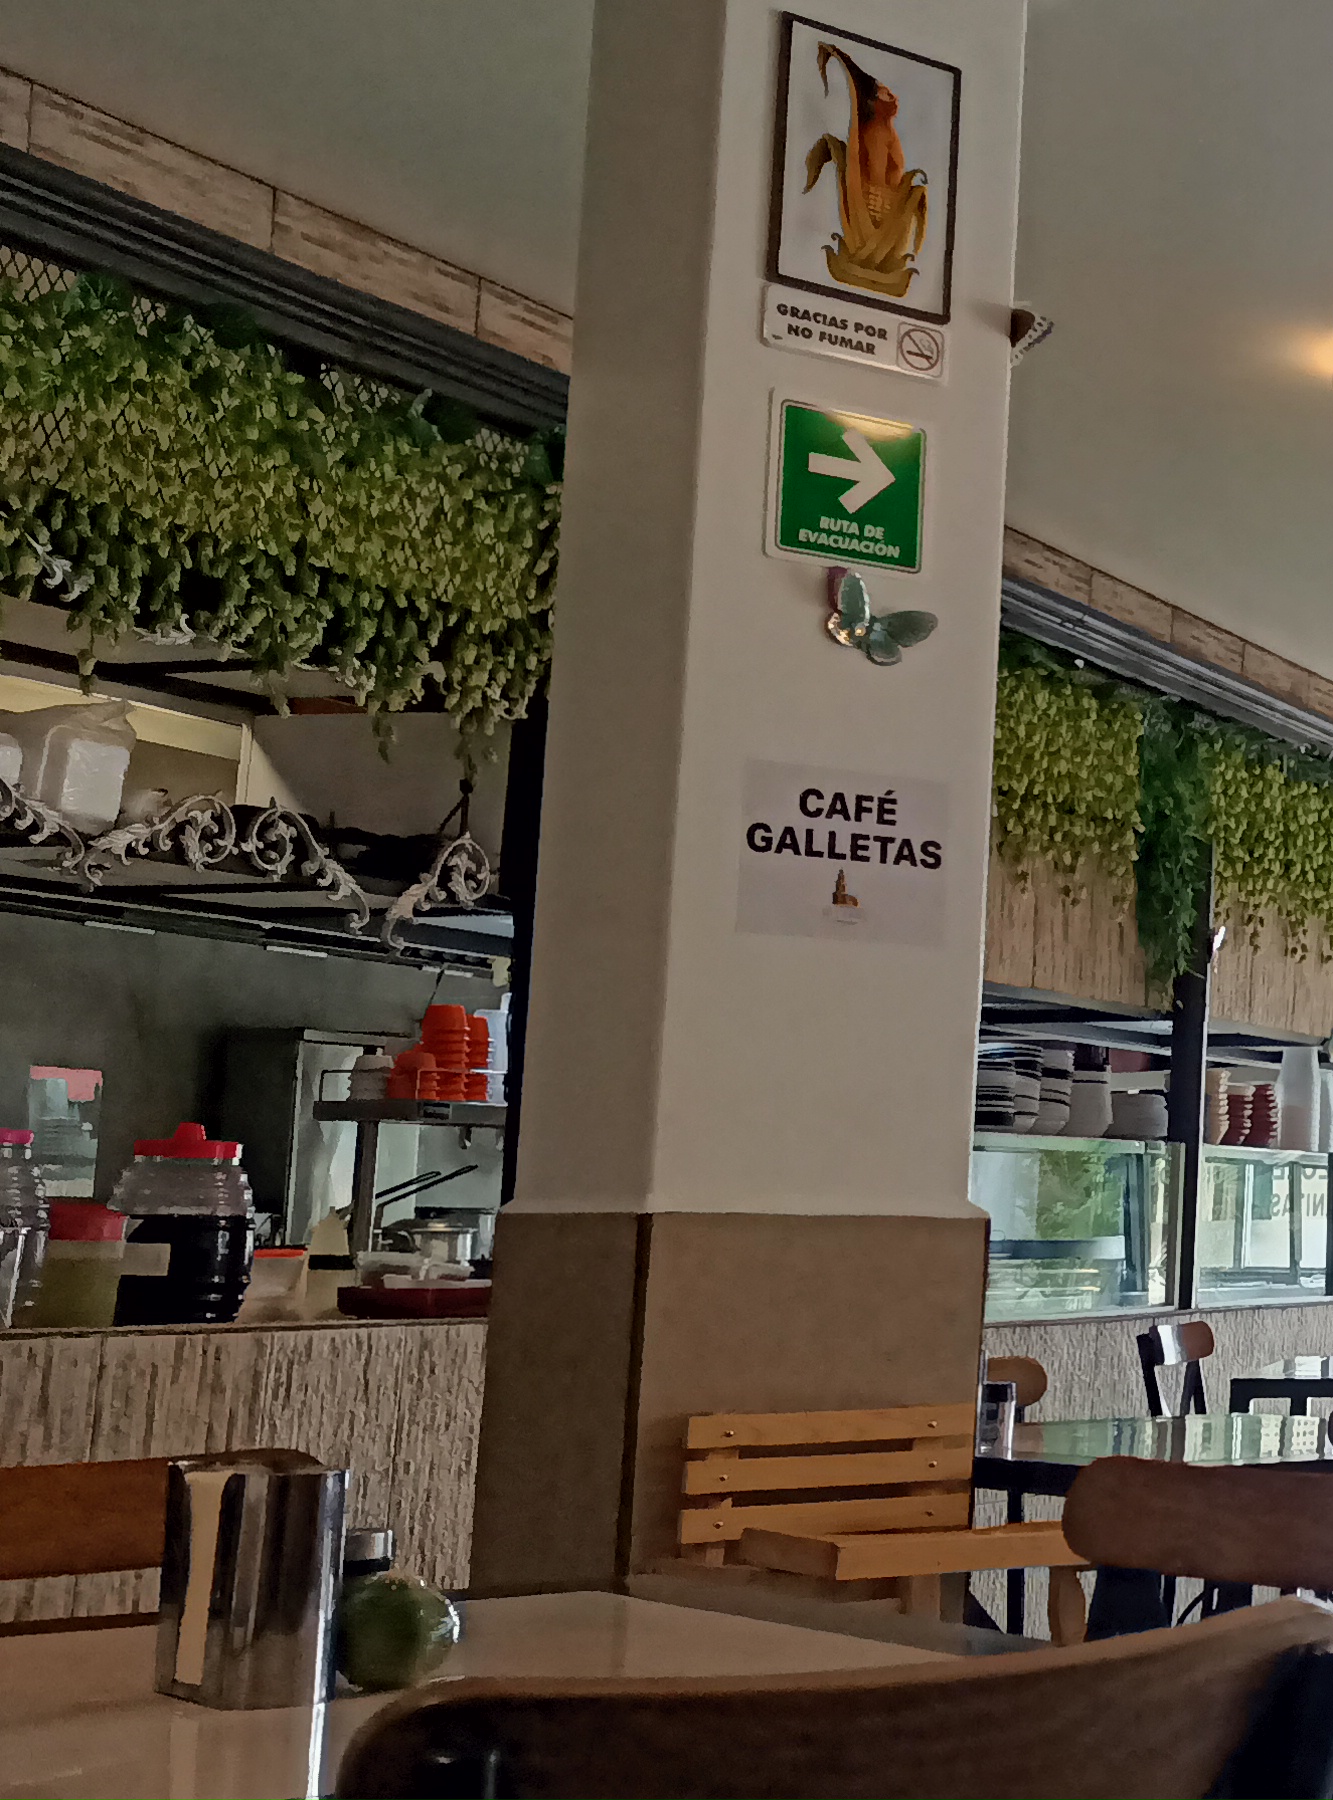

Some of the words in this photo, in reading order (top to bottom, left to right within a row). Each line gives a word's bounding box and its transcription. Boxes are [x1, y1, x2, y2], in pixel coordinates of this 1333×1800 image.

[776, 303, 848, 330] GRACIAS
[854, 322, 888, 340] POR
[787, 323, 813, 339] NO
[818, 331, 876, 355] FUMAR
[798, 528, 900, 558] EVACUACIÓN
[820, 516, 859, 535] RUTA
[864, 524, 885, 539] DE
[799, 787, 898, 826] CAFÉ
[746, 822, 942, 870] GALLETAS
